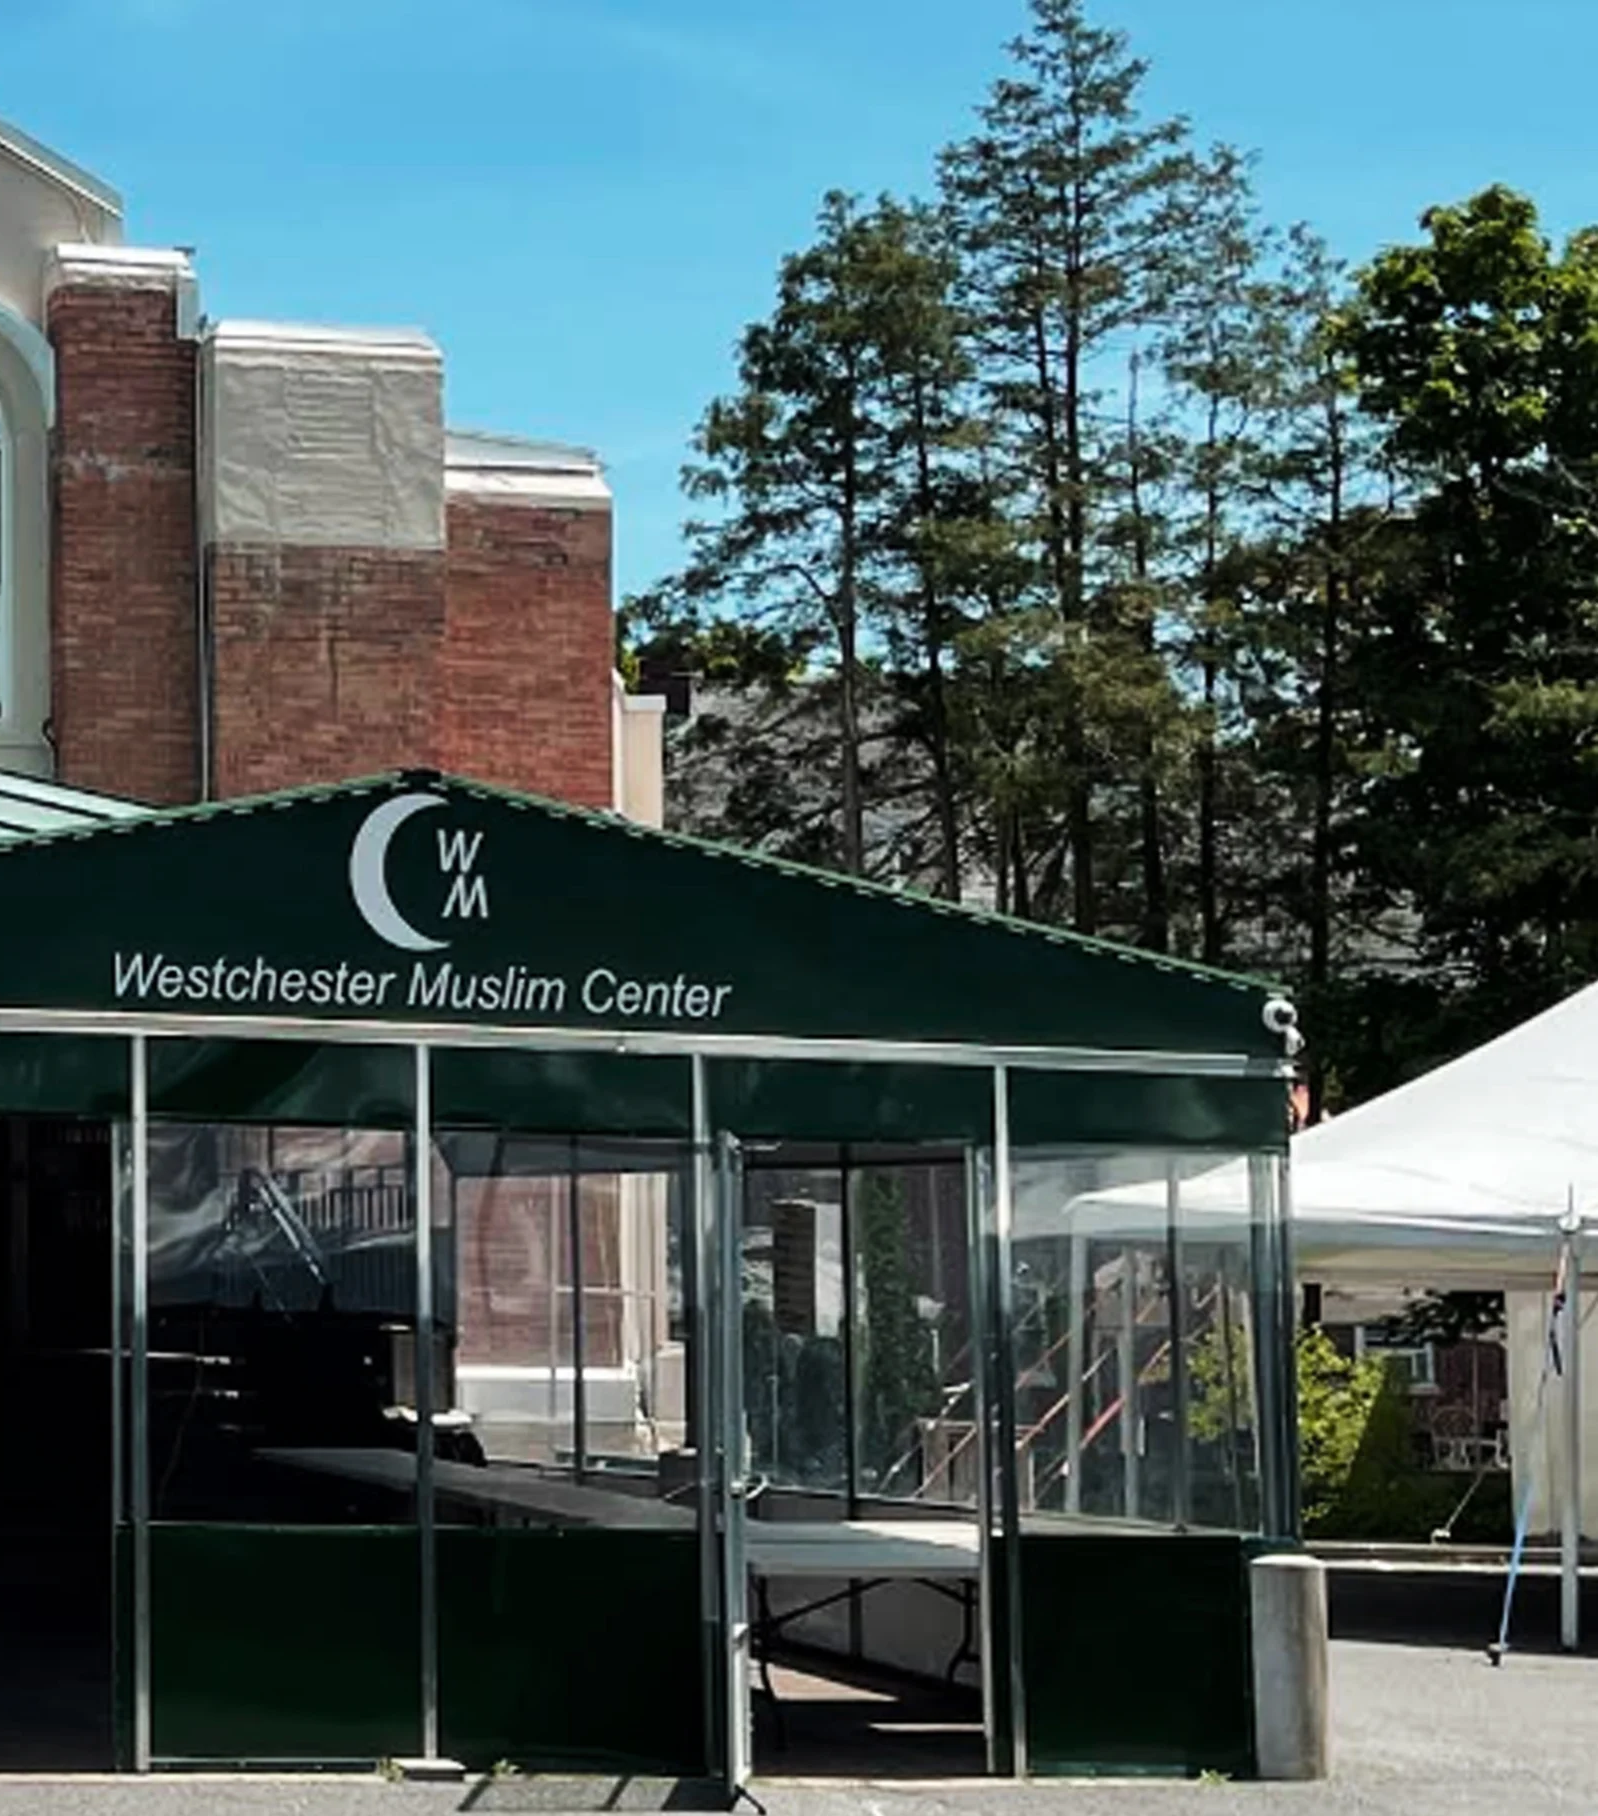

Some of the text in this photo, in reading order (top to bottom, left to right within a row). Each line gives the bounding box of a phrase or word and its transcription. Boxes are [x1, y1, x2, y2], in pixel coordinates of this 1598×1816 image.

[436, 829, 484, 873] W
[442, 875, 490, 919] M
[113, 952, 732, 1018] Westchester Muslim Center
